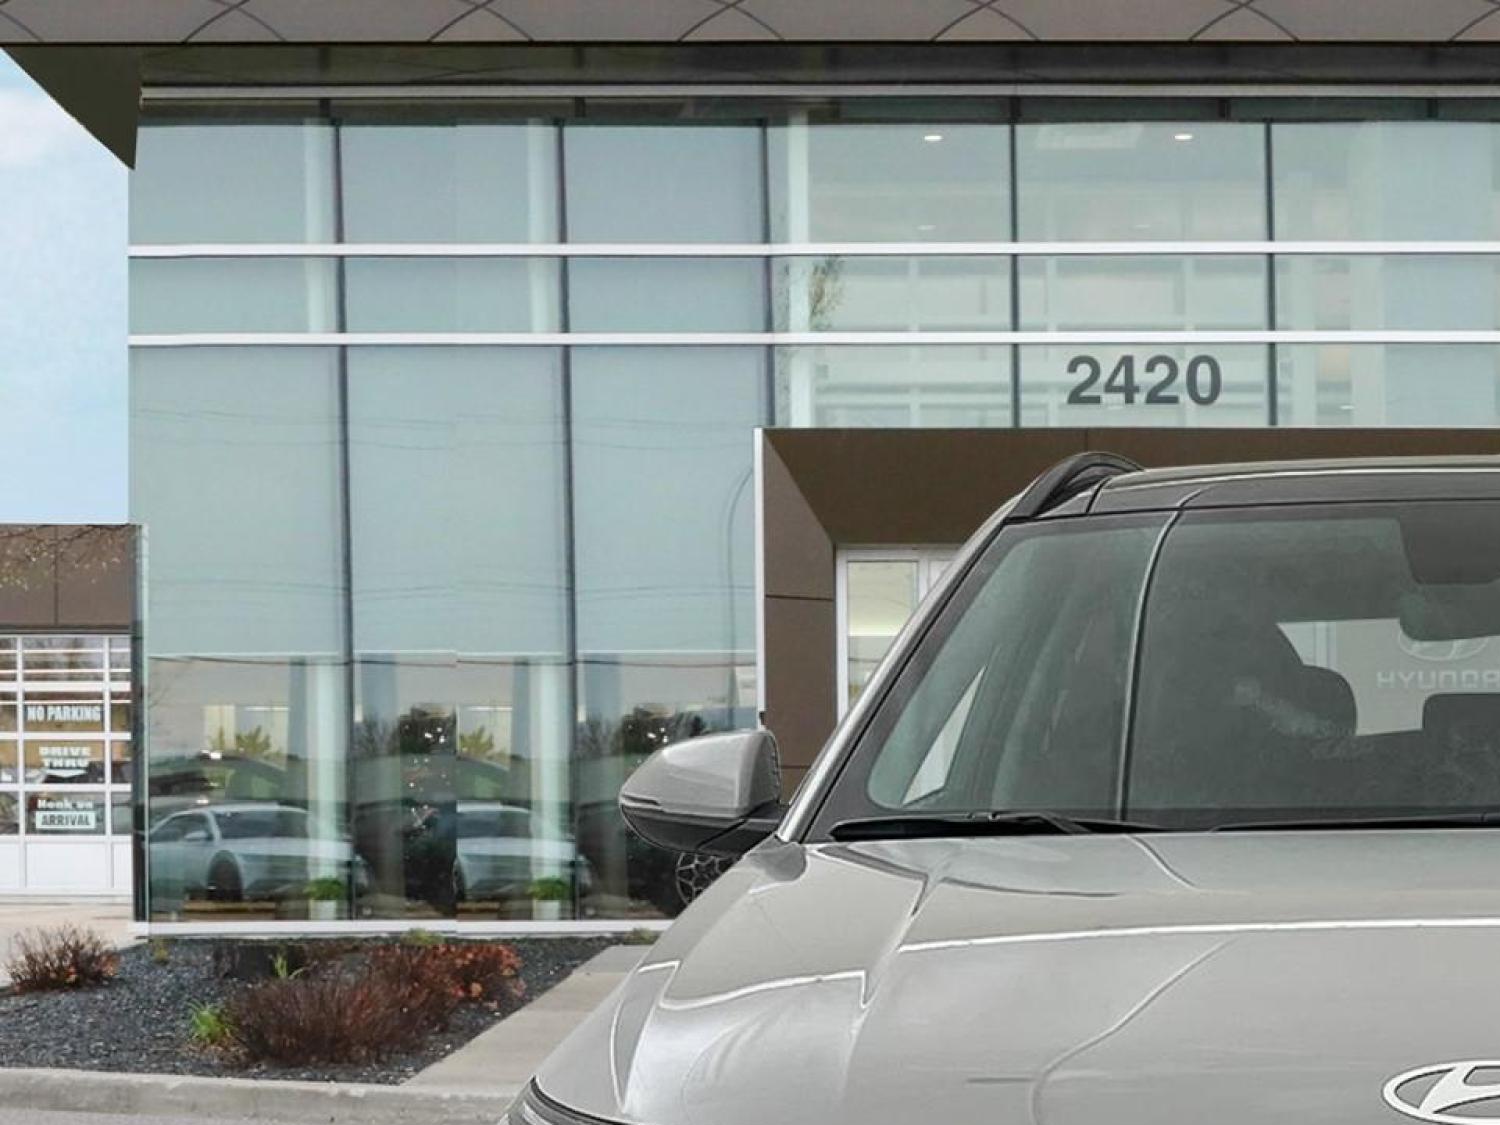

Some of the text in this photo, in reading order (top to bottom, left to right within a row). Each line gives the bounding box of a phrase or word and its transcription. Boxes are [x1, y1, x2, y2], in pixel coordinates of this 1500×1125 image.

[1066, 354, 1222, 406] 2420
[27, 705, 101, 721] NO PARKING
[41, 814, 91, 826] ARRIVAL
